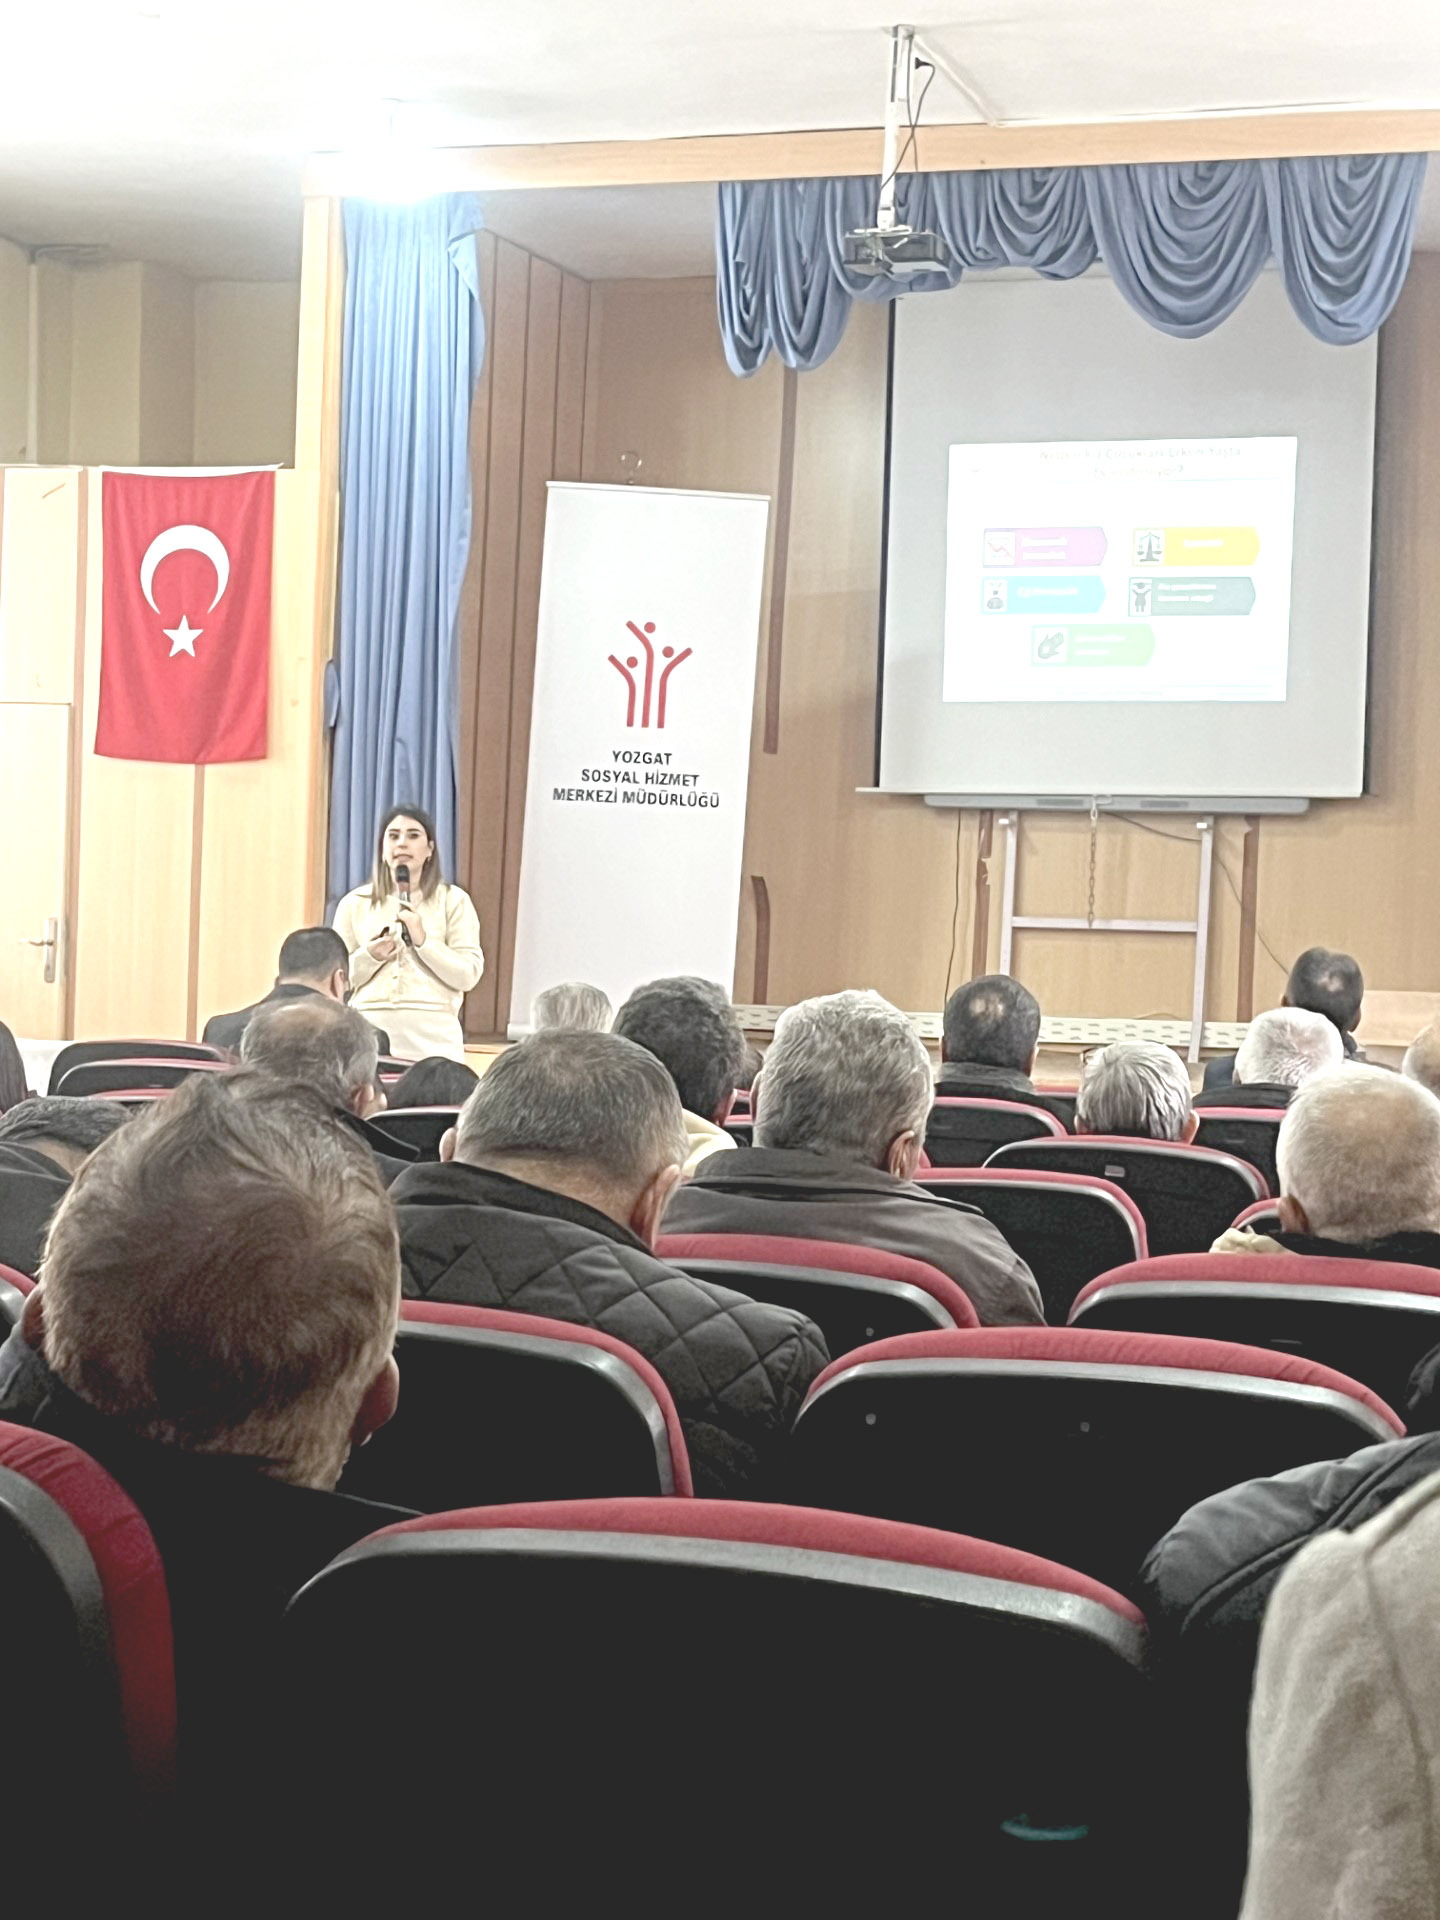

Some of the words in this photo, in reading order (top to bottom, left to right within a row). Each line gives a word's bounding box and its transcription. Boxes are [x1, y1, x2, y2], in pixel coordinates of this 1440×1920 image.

[612, 750, 673, 766] YOZGAT
[581, 768, 640, 784] SOSYAL
[645, 769, 700, 787] HİZMET
[552, 787, 618, 803] MERKEZİ
[622, 788, 720, 808] MÜDÜRLÜĞÜ
